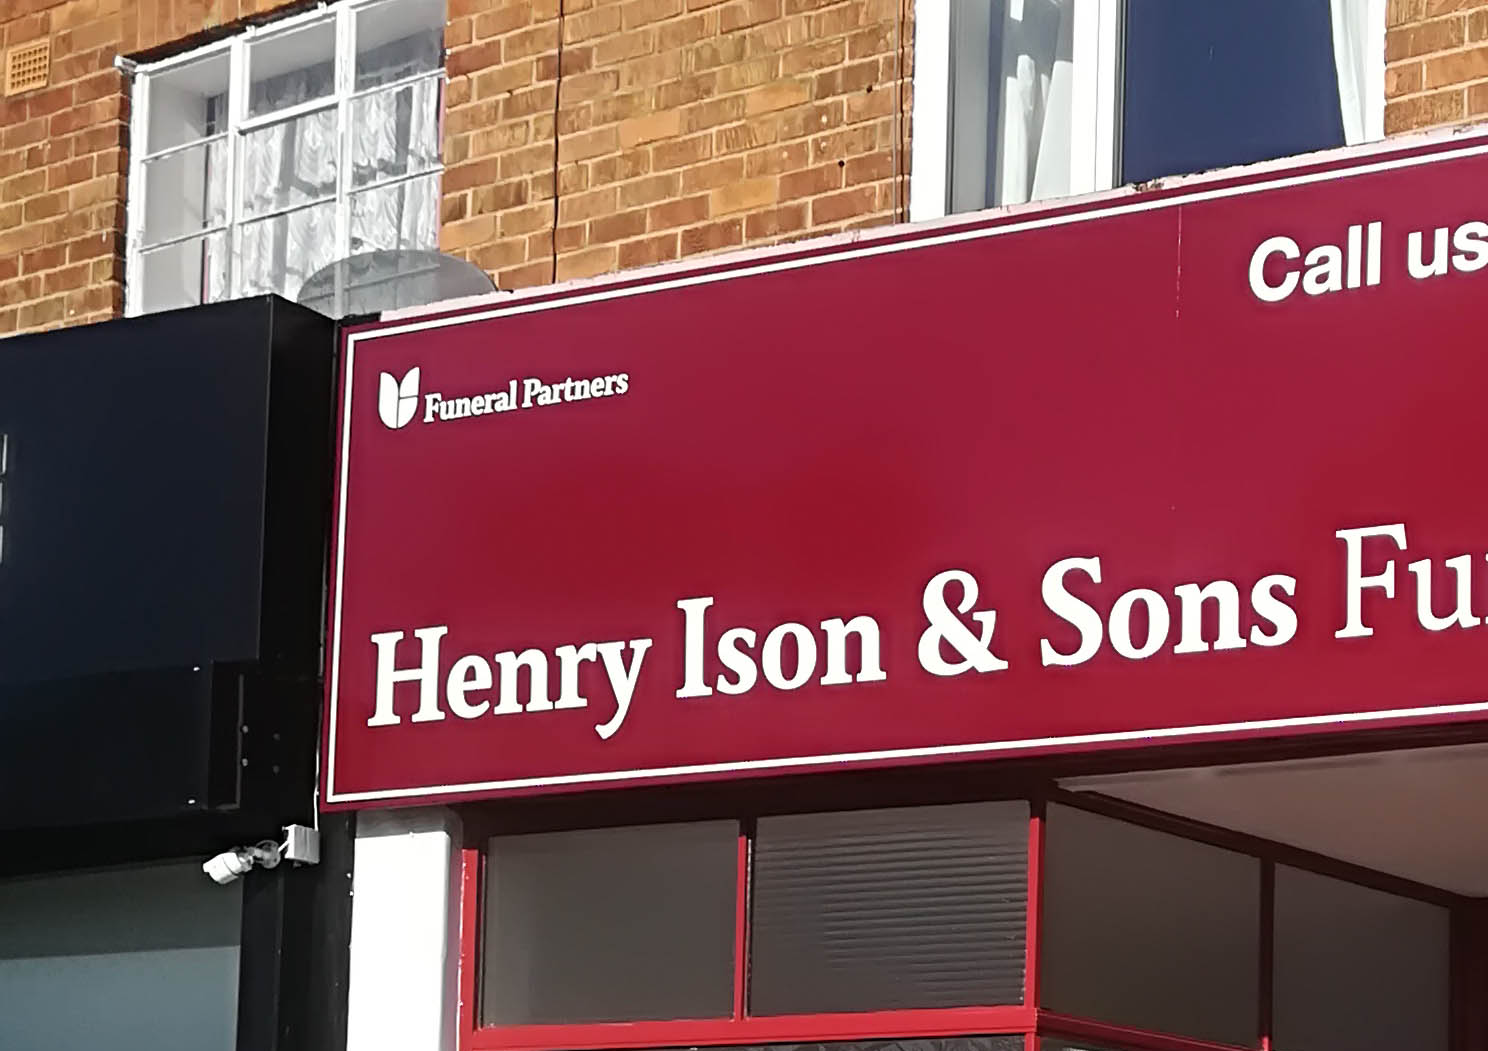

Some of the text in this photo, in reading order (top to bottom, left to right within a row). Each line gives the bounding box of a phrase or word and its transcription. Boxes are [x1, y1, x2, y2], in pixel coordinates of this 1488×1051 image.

[1248, 220, 1382, 302] Call
[423, 372, 630, 423] Funeral Partners
[366, 625, 653, 740] Henry
[675, 596, 887, 700] Ison
[917, 568, 1009, 678] &
[1040, 556, 1299, 667] Sons
